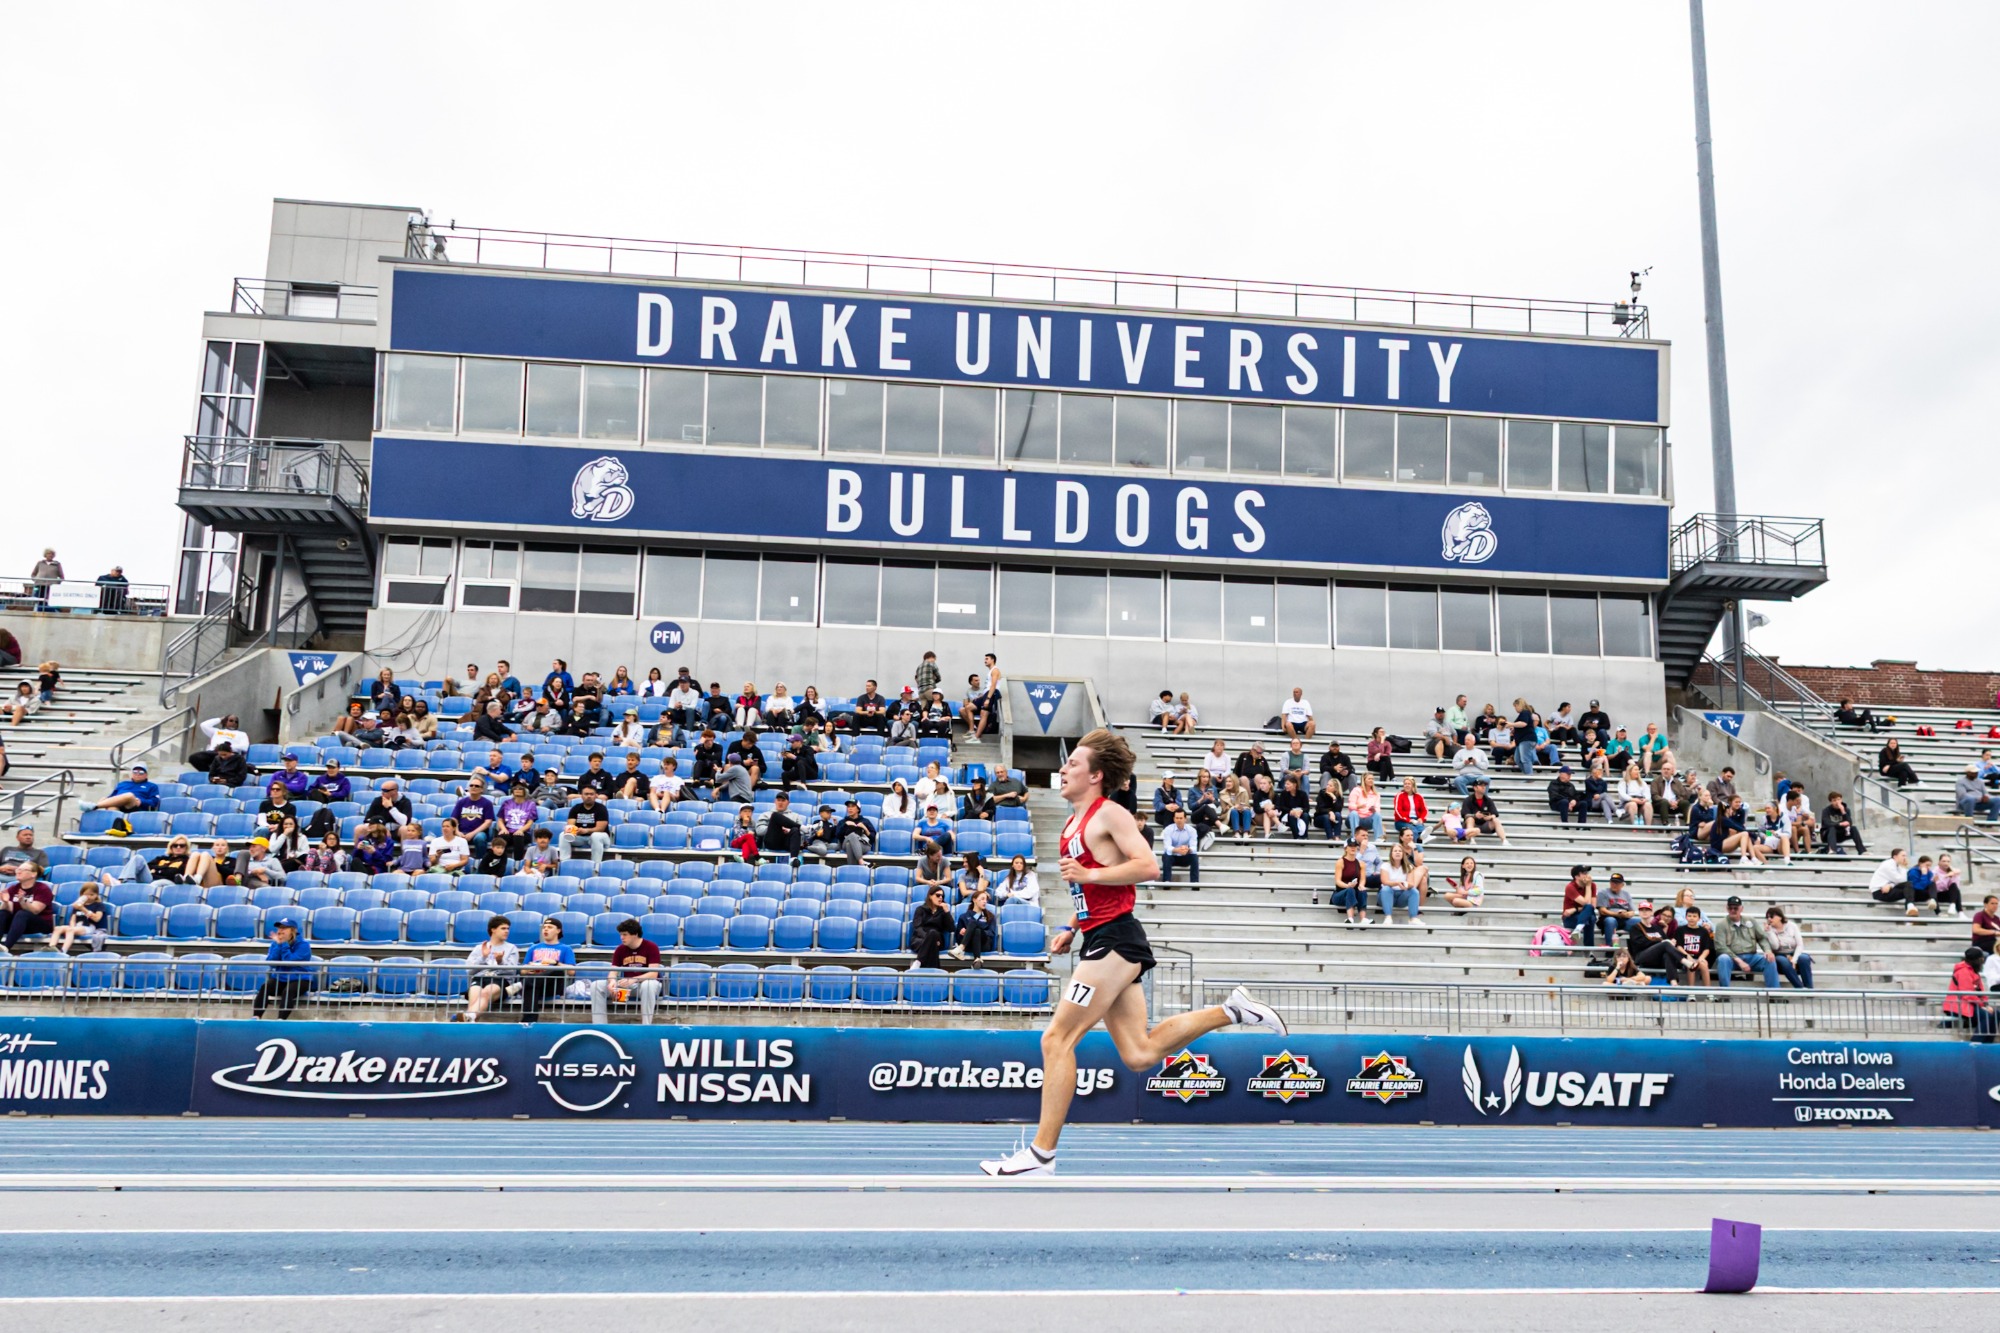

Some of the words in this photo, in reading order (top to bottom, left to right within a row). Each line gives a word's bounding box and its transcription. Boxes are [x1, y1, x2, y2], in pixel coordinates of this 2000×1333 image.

[636, 292, 912, 371] DRAKE
[955, 311, 1463, 403] UNIVERSITY
[826, 468, 1267, 552] BULLDOGS
[653, 630, 681, 645] PFM
[300, 660, 308, 670] V
[313, 660, 324, 670] W
[1034, 689, 1044, 698] W
[1050, 689, 1057, 698] X
[1714, 720, 1722, 729] X
[1728, 720, 1735, 729] Y
[1071, 836, 1079, 856] 17
[1071, 983, 1091, 1004] 17
[247, 1038, 387, 1084] Drake
[388, 1057, 499, 1084] RELAYS
[660, 1038, 794, 1069] WILLIS
[1787, 1047, 1848, 1065] Central
[1853, 1048, 1893, 1065] Iowa
[0, 1059, 110, 1100] MOINES
[535, 1063, 636, 1077] NISSAN
[868, 1060, 1115, 1096] @DrakeReys
[656, 1073, 810, 1103] NISSAN
[1149, 1079, 1181, 1089] PRAIRIE
[1183, 1080, 1222, 1089] MEADOWS
[1250, 1080, 1281, 1089] PRAIRIE
[1283, 1080, 1322, 1090] MEADOWS
[1349, 1081, 1380, 1090] PRAIRIE
[1381, 1081, 1420, 1091] MEADOWS
[1525, 1071, 1669, 1107] USATF
[1779, 1072, 1837, 1090] Honda
[1841, 1072, 1905, 1091] Dealers
[1814, 1107, 1894, 1120] HONDA
